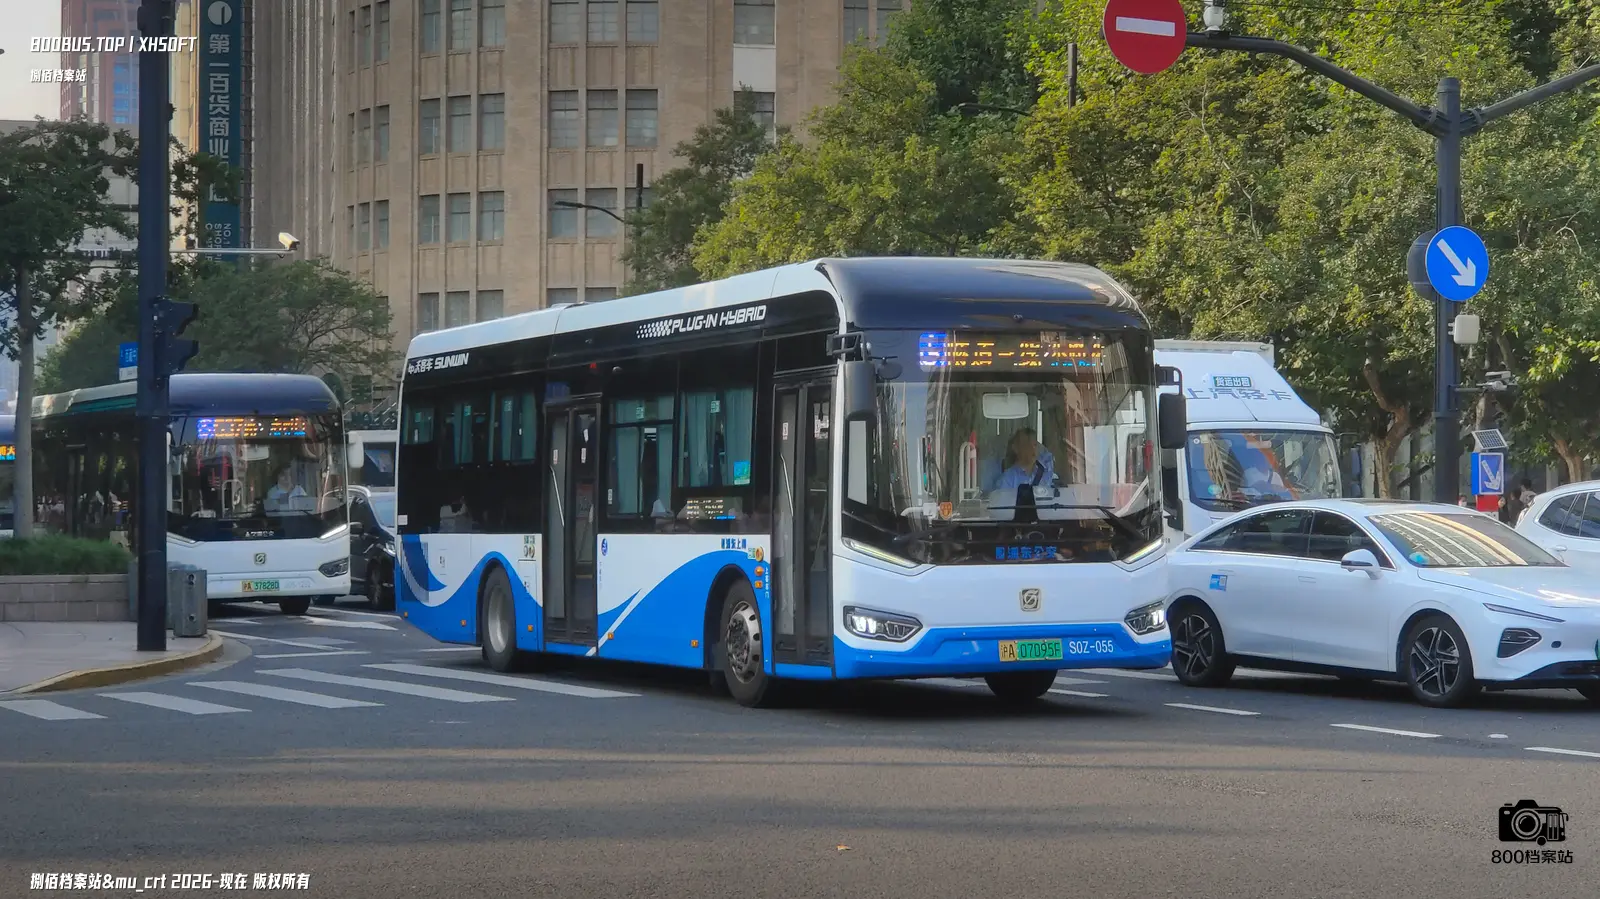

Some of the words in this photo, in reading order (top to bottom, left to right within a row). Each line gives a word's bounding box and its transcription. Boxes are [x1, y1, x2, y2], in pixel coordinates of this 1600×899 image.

[671, 313, 718, 334] PLUG-IN
[719, 305, 767, 327] HYBRID
[434, 353, 470, 370] SUNWIN
[1186, 388, 1292, 401] 上汽轻卡
